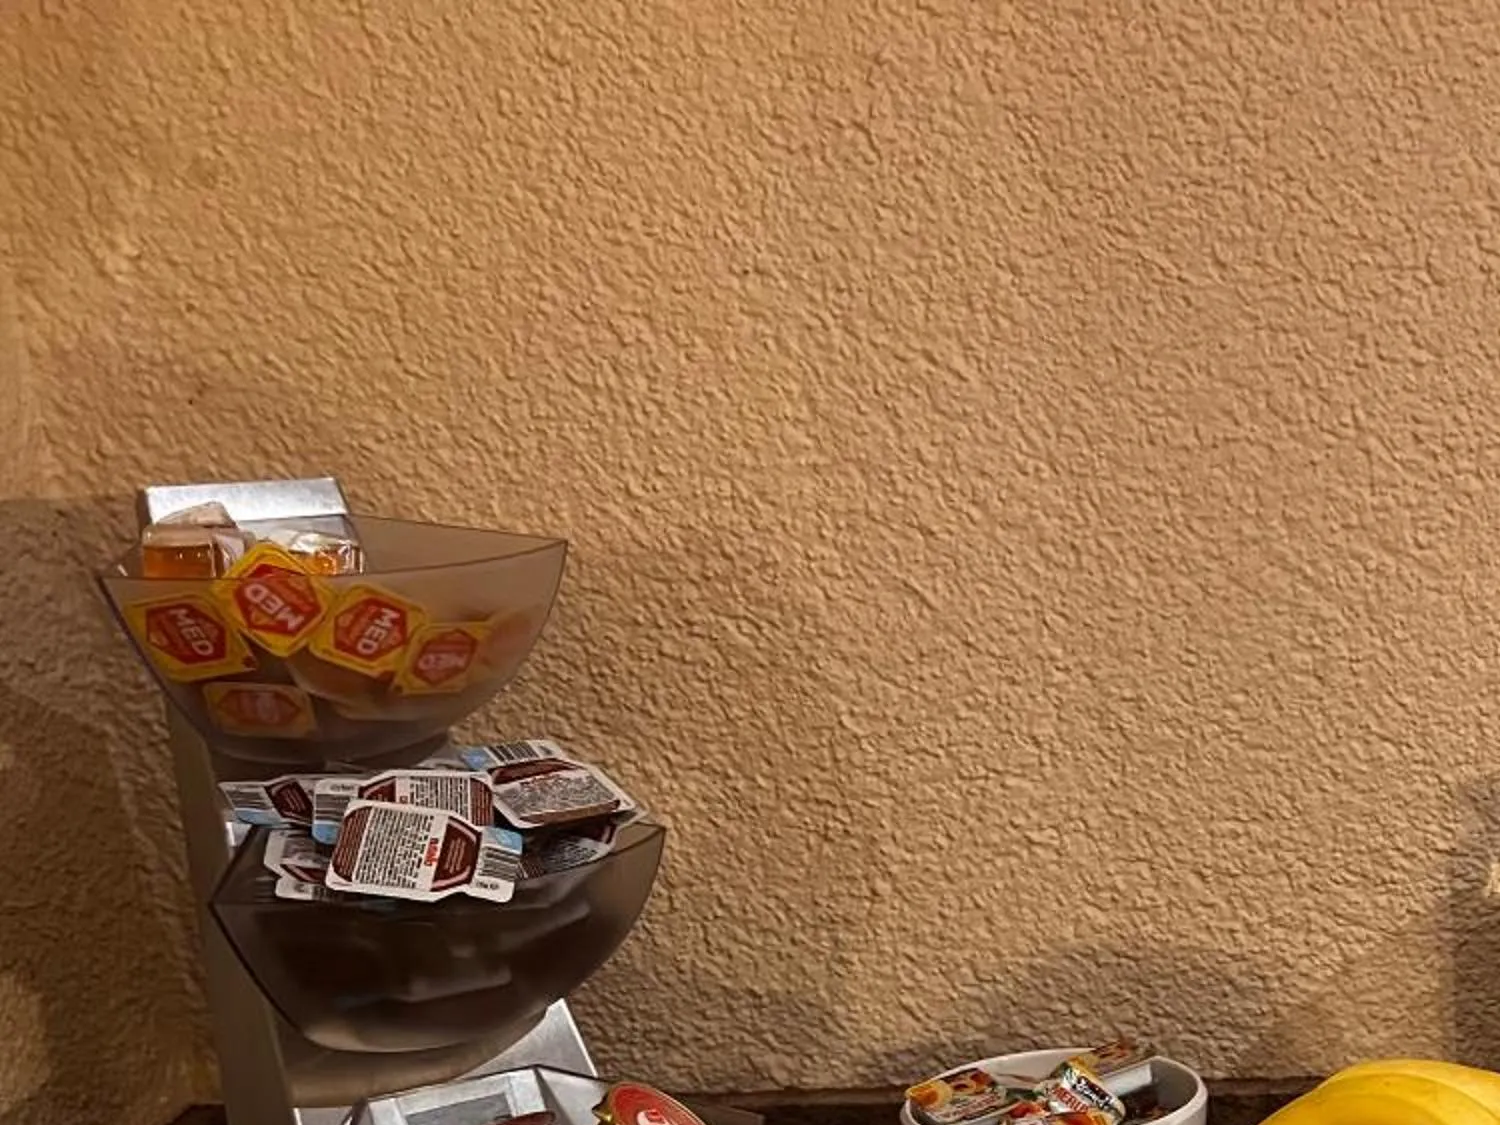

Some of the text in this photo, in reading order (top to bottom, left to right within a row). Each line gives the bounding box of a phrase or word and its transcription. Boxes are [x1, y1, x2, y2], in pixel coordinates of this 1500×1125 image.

[244, 582, 305, 631] MED
[356, 606, 401, 655] MED
[169, 608, 214, 656] MED
[417, 652, 468, 671] MED
